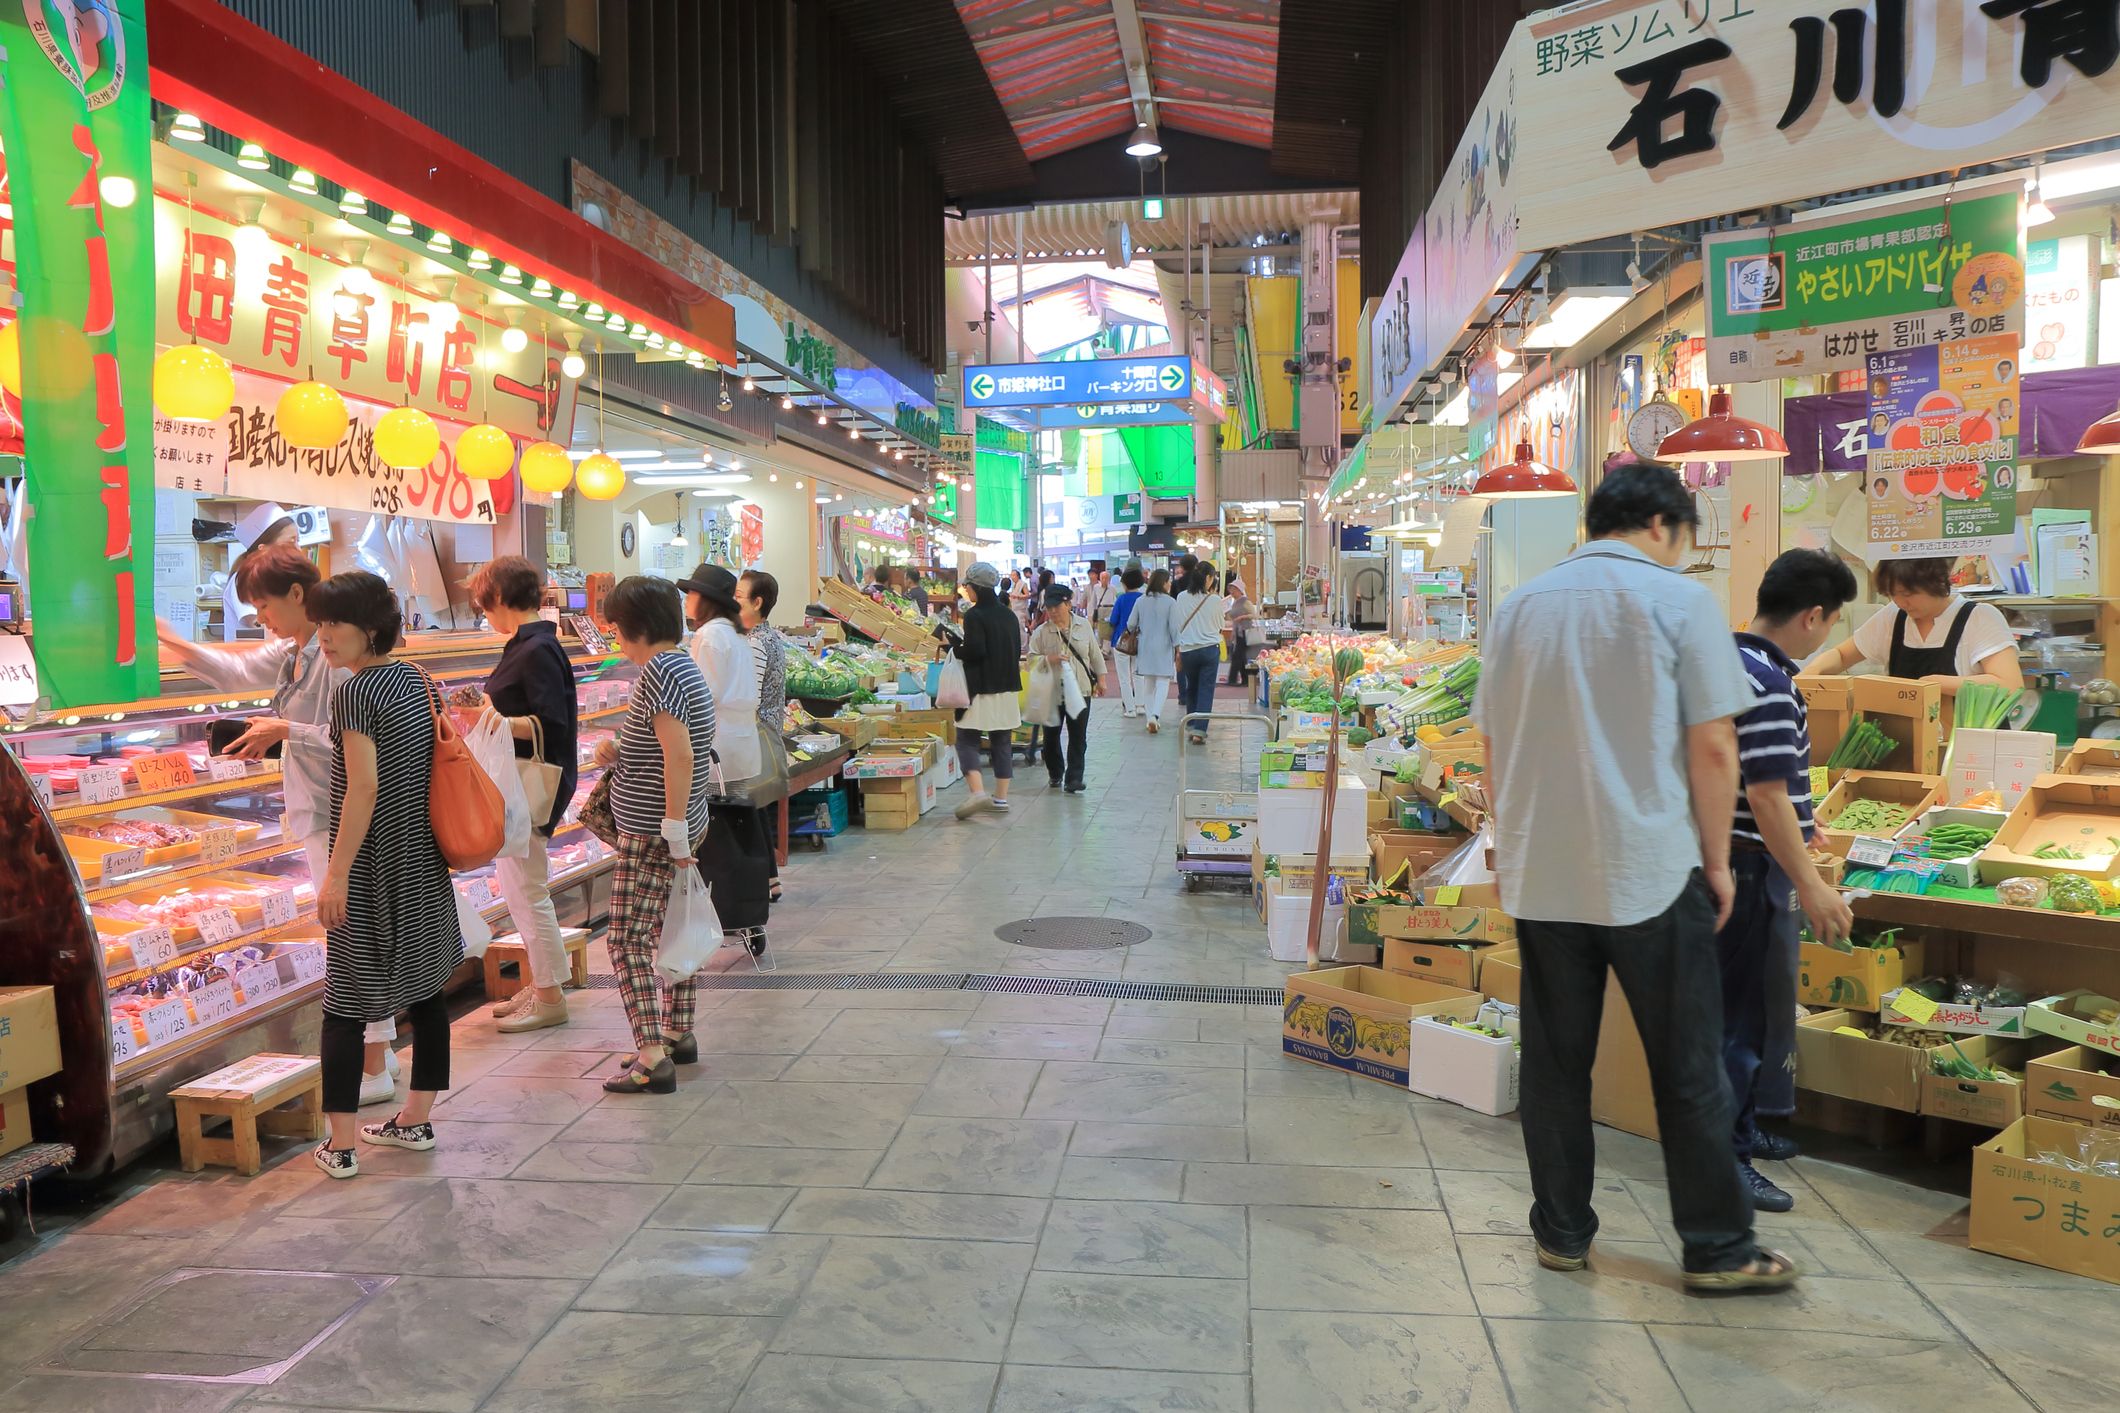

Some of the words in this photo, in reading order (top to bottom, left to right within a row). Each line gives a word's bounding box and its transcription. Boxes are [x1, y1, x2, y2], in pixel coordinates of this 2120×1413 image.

[1796, 223, 1948, 263] 近江町市場青果部認定
[1893, 318, 1925, 333] 石川
[1950, 312, 1965, 326] 昇
[1971, 314, 2006, 335] の店
[1824, 329, 1879, 358] はかせ
[1894, 334, 1926, 348] 石川
[1869, 355, 1887, 369] 6.1
[1921, 424, 1961, 446] 和食
[1154, 471, 1164, 482] 13
[297, 511, 314, 535] 9
[1871, 526, 1900, 539] 6.22
[1945, 521, 1975, 535] 6.29
[140, 758, 185, 774] ロースハム
[1407, 915, 1452, 930] 甘とう美人
[1292, 1043, 1329, 1062] BANANAS
[1355, 1060, 1396, 1081] PREMIUM
[1992, 1163, 2083, 1194] 石川県小松産
